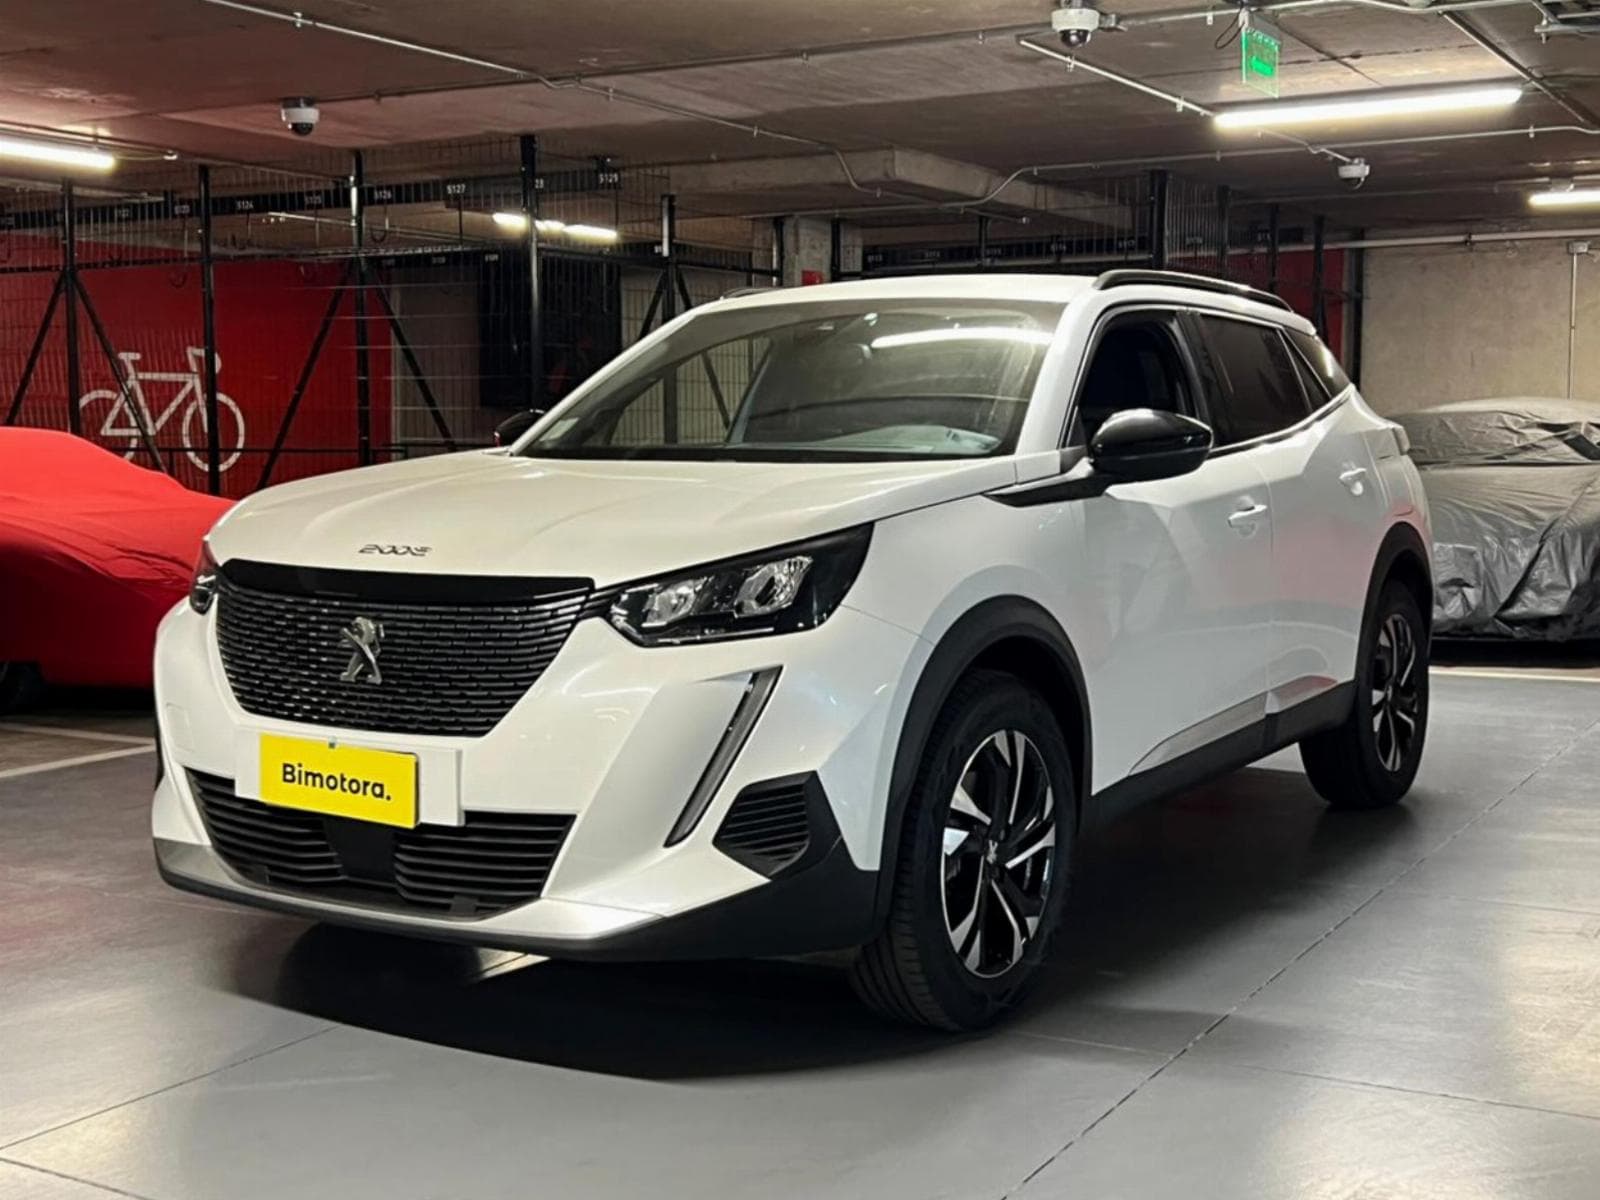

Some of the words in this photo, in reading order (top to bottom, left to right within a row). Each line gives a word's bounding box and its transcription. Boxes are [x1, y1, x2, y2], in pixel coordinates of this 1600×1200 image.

[447, 184, 466, 194] S127
[236, 200, 254, 210] S124
[282, 763, 391, 801] Bimotora.
